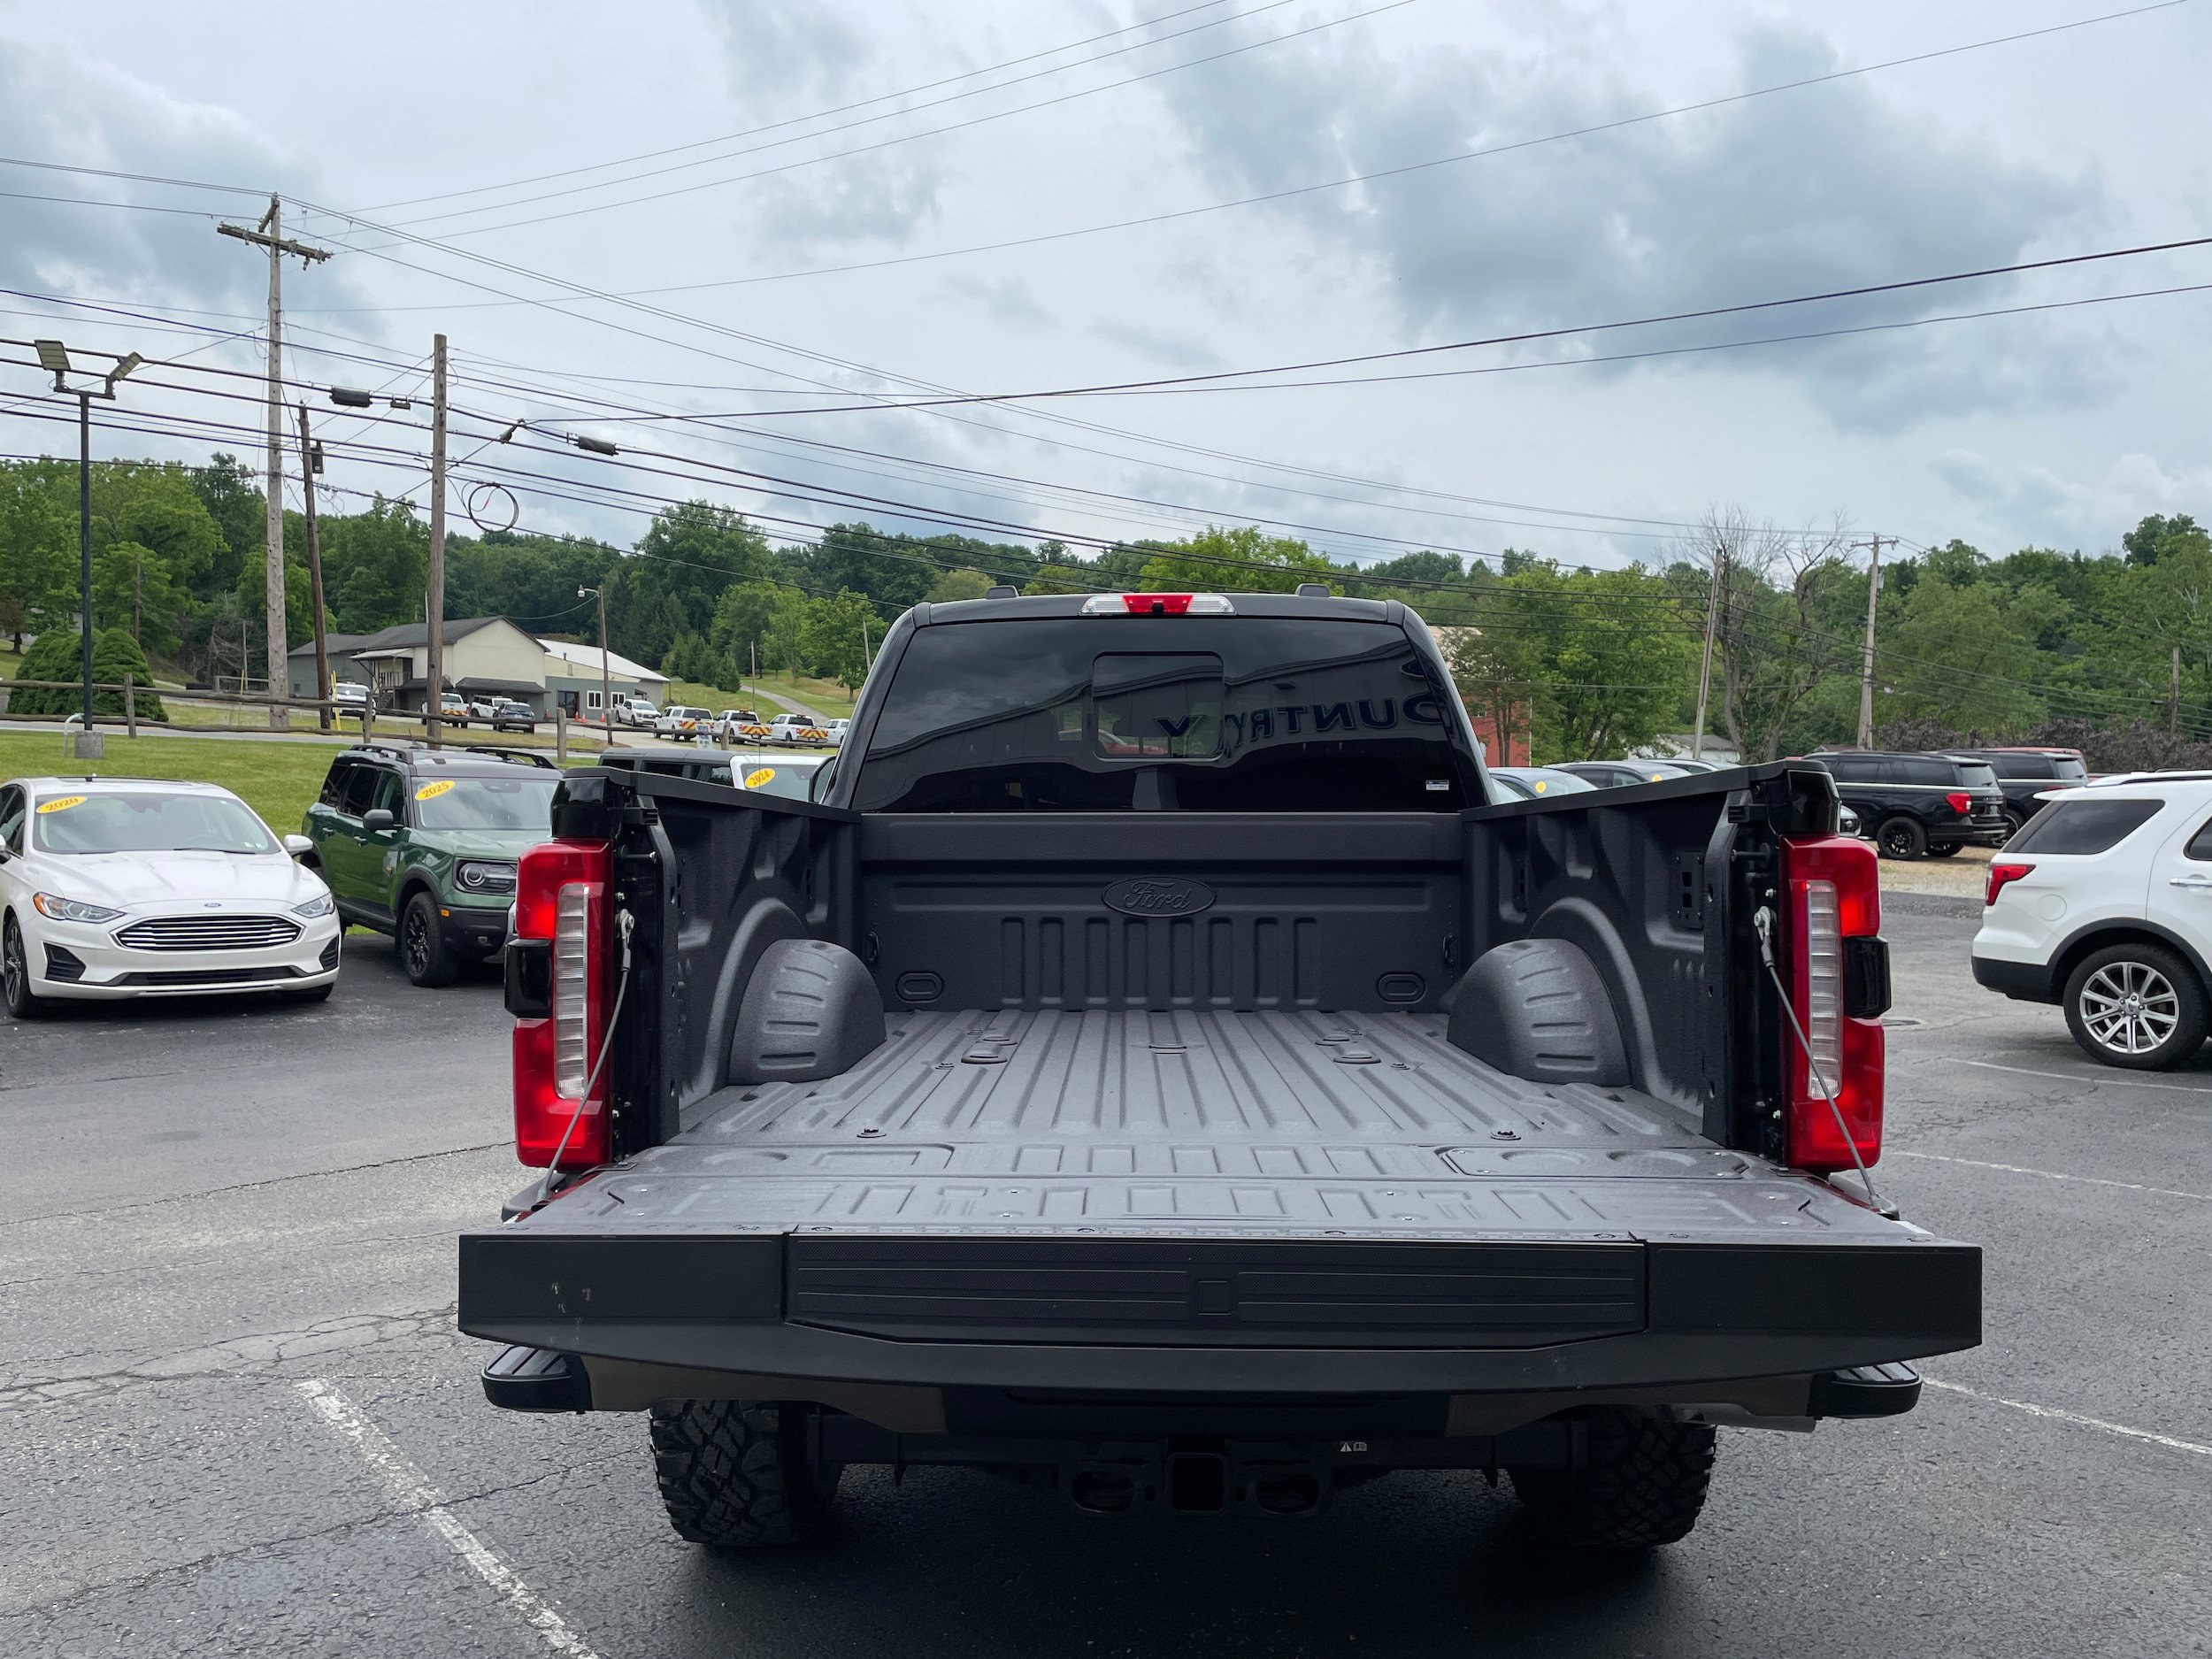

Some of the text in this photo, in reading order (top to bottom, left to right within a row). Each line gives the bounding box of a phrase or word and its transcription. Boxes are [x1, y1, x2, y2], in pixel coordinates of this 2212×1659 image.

[750, 770, 771, 786] 2024
[423, 781, 449, 797] 2025
[1124, 880, 1192, 909] Ford
